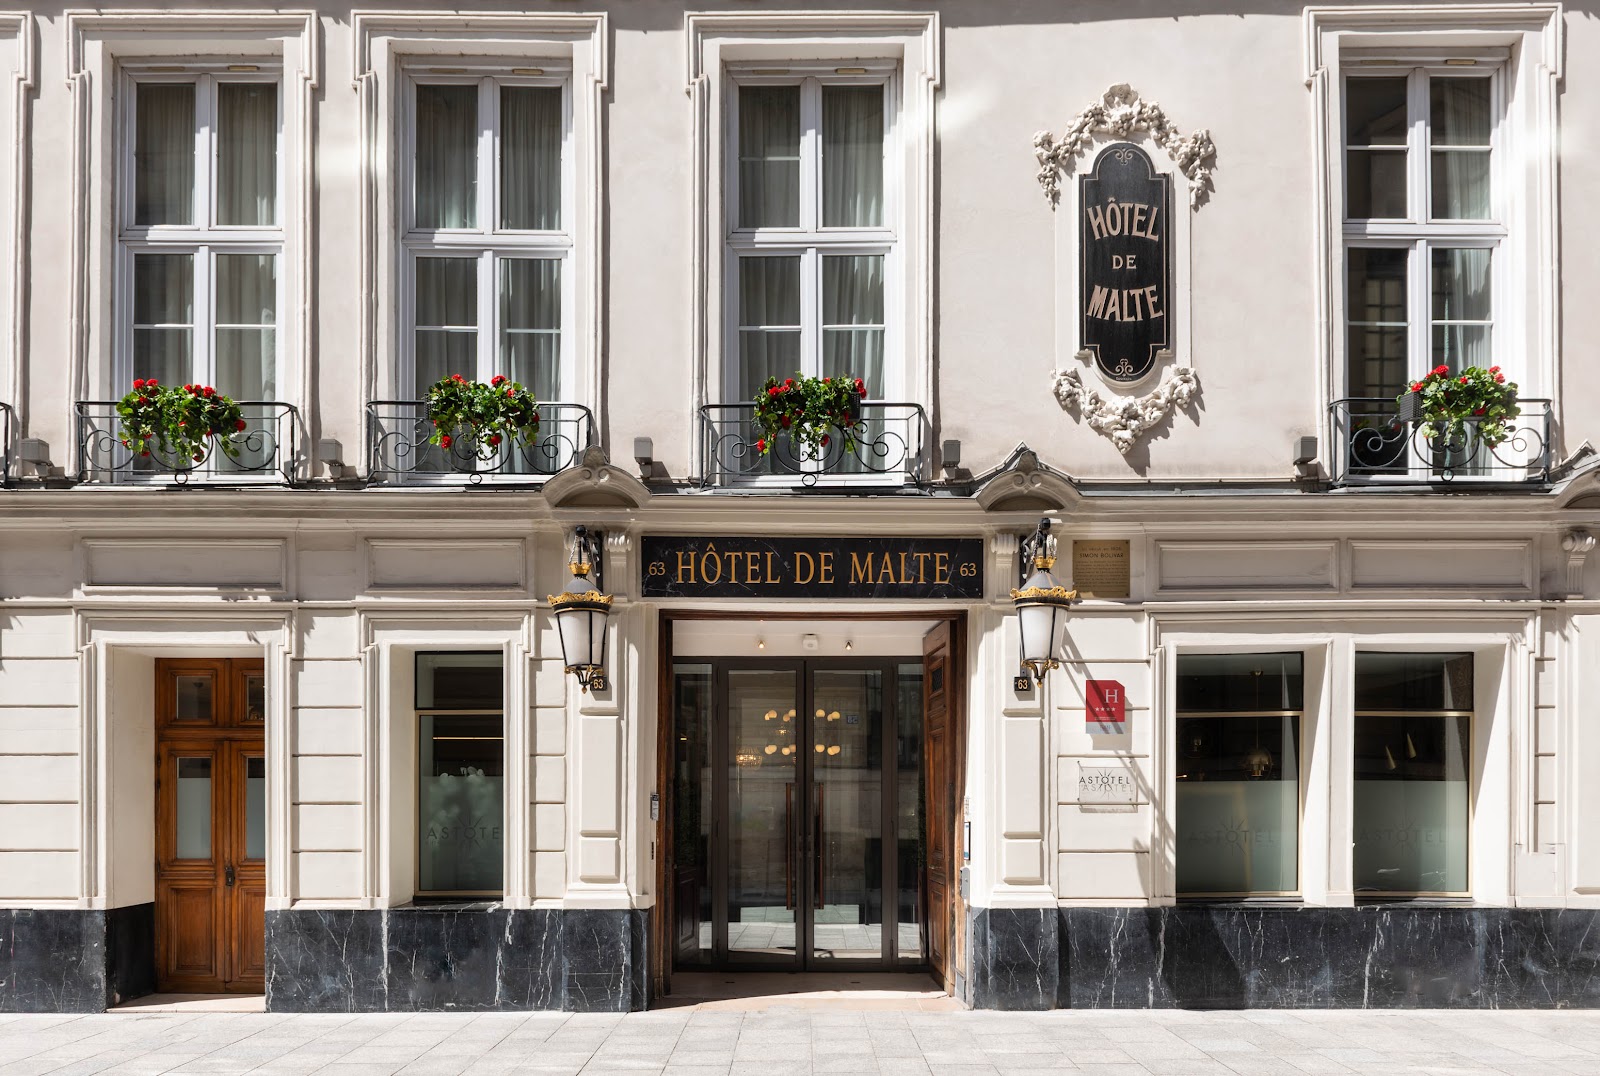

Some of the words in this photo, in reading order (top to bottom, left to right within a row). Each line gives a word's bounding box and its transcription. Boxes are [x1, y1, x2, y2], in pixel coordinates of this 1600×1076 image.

[1087, 197, 1159, 242] HÔTEL
[1112, 255, 1137, 270] DE
[1086, 285, 1164, 322] MALTE
[648, 561, 666, 576] 63
[676, 542, 781, 584] HÔTEL
[794, 552, 835, 584] DE
[849, 552, 950, 584] MALTE
[959, 562, 977, 577] 63
[593, 679, 604, 689] 63
[1017, 679, 1028, 689] 63
[1104, 689, 1119, 703] H
[1079, 776, 1130, 785] ASTOTEL
[426, 826, 499, 840] ASTOTE
